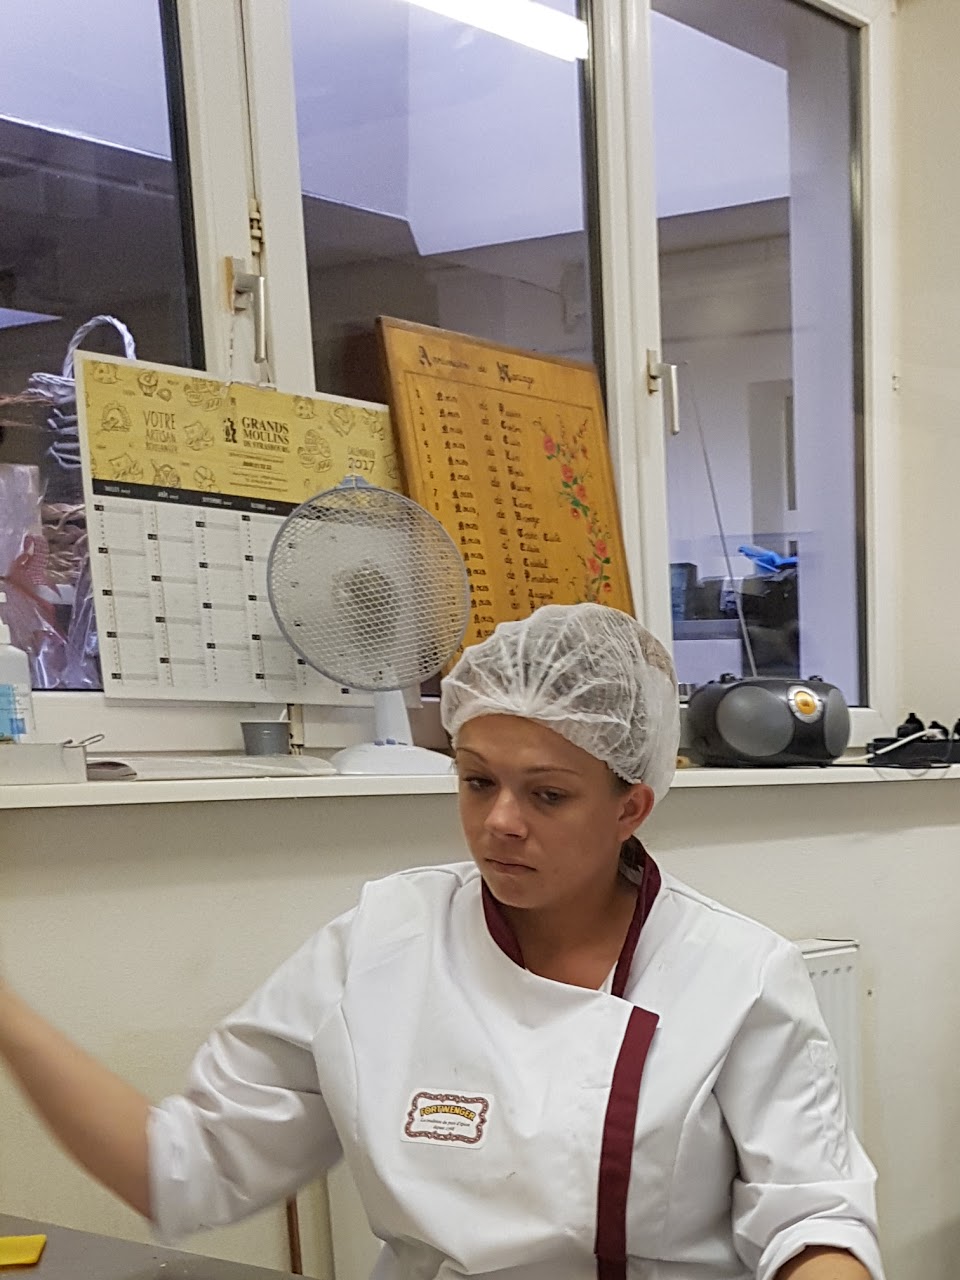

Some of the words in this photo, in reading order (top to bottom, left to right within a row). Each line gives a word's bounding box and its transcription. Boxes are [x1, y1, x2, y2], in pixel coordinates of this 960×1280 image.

[143, 410, 176, 430] VOTRE
[241, 416, 290, 435] GRANDS
[243, 429, 290, 445] MOULINS
[348, 457, 375, 474] 2017
[419, 1104, 476, 1122] FORTWENGER
